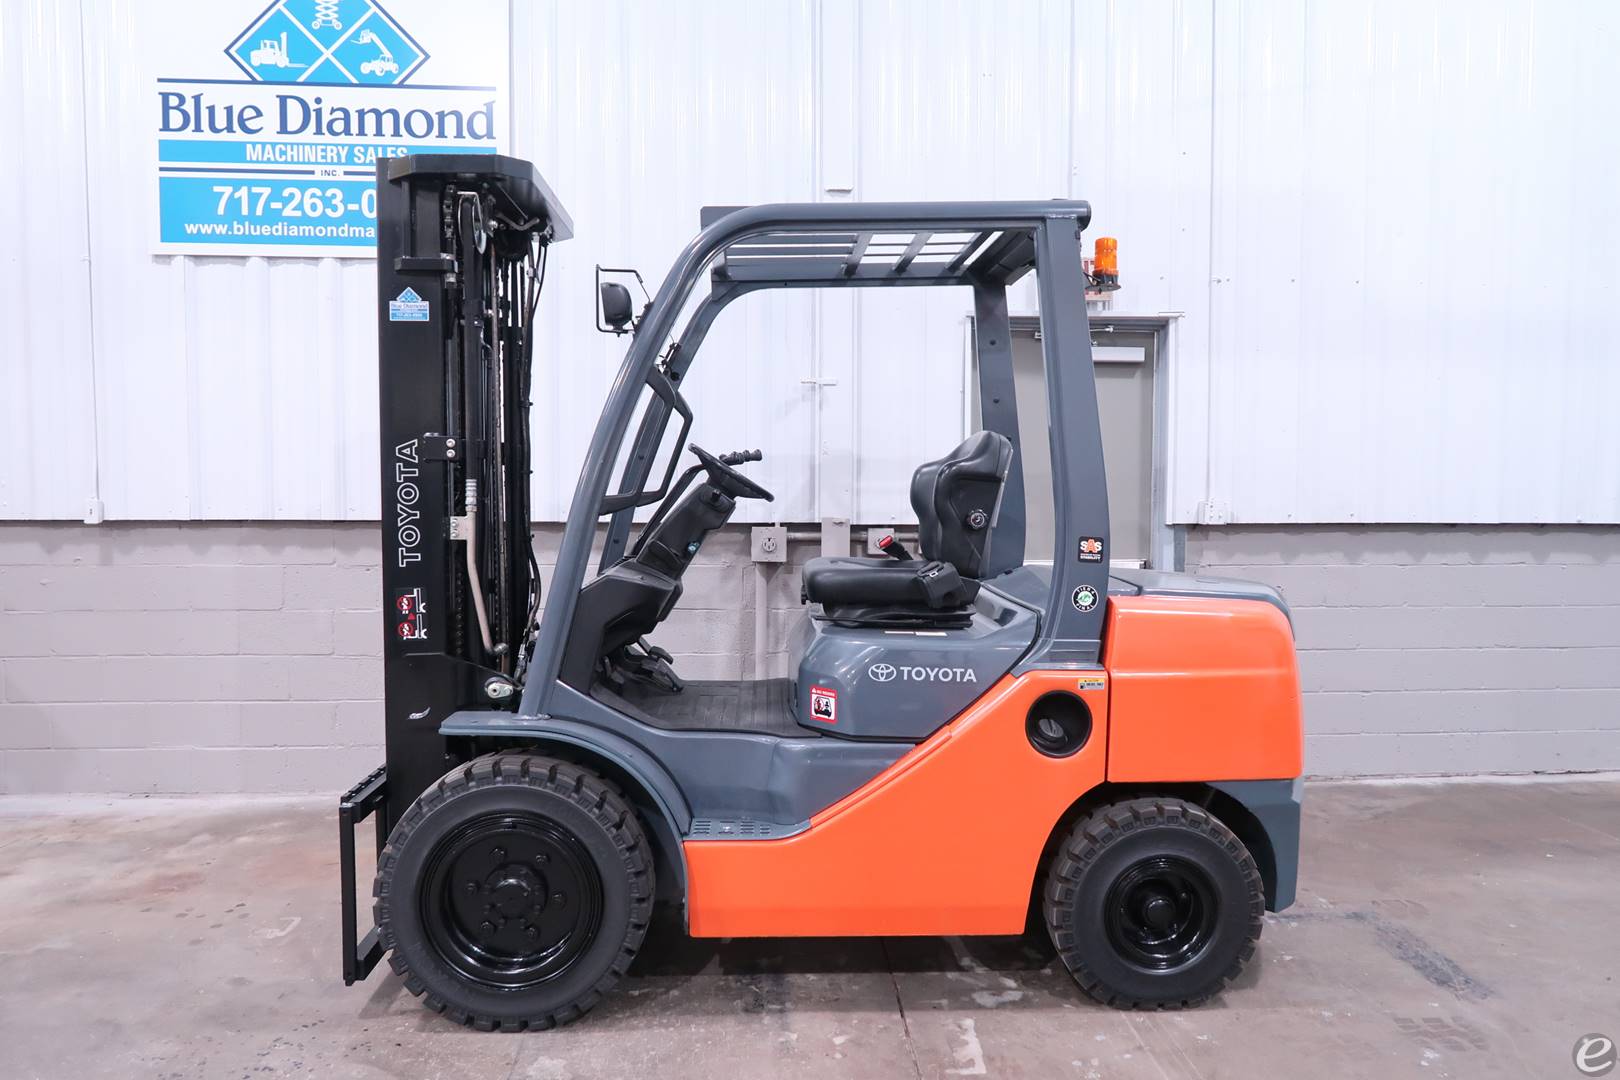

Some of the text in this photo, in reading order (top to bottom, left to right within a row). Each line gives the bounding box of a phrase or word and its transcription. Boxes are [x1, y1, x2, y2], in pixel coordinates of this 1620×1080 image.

[158, 92, 497, 140] Blue Diamond
[246, 143, 349, 163] MACHINERY
[320, 169, 341, 177] INC.
[184, 220, 376, 238] www.bluediamondma
[396, 438, 421, 567] TOYOTA
[1080, 538, 1102, 553] SAS
[900, 666, 977, 682] TOYOTA
